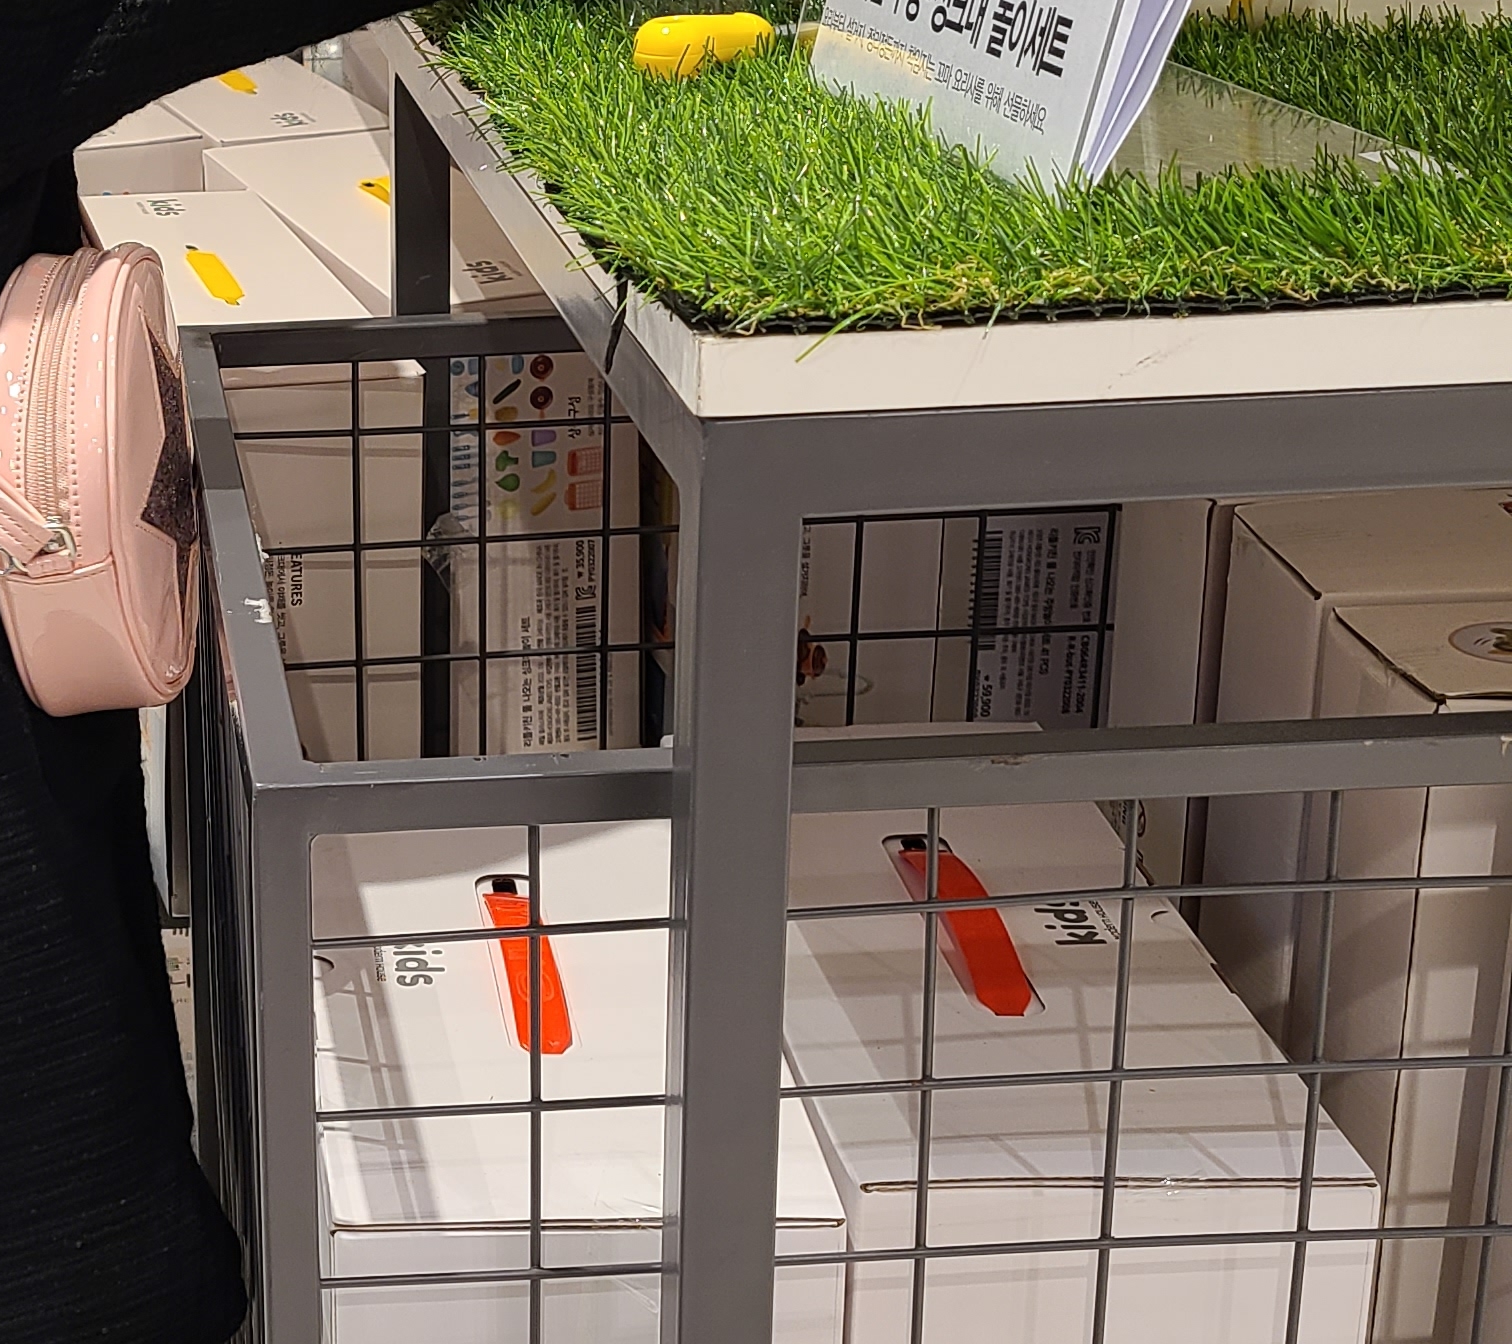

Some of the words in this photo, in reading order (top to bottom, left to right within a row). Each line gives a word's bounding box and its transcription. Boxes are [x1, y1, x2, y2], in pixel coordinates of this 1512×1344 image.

[936, 61, 954, 91] 꼬마
[952, 67, 986, 105] 요리사를
[985, 79, 1005, 114] 위해
[146, 198, 186, 217] kids
[462, 260, 514, 285] kids
[568, 396, 582, 439] 상구성
[291, 553, 303, 606] EATURES
[521, 635, 532, 676] 싱크놀이
[522, 678, 532, 702] 나오는
[980, 684, 993, 718] 59,900
[393, 943, 446, 987] ids
